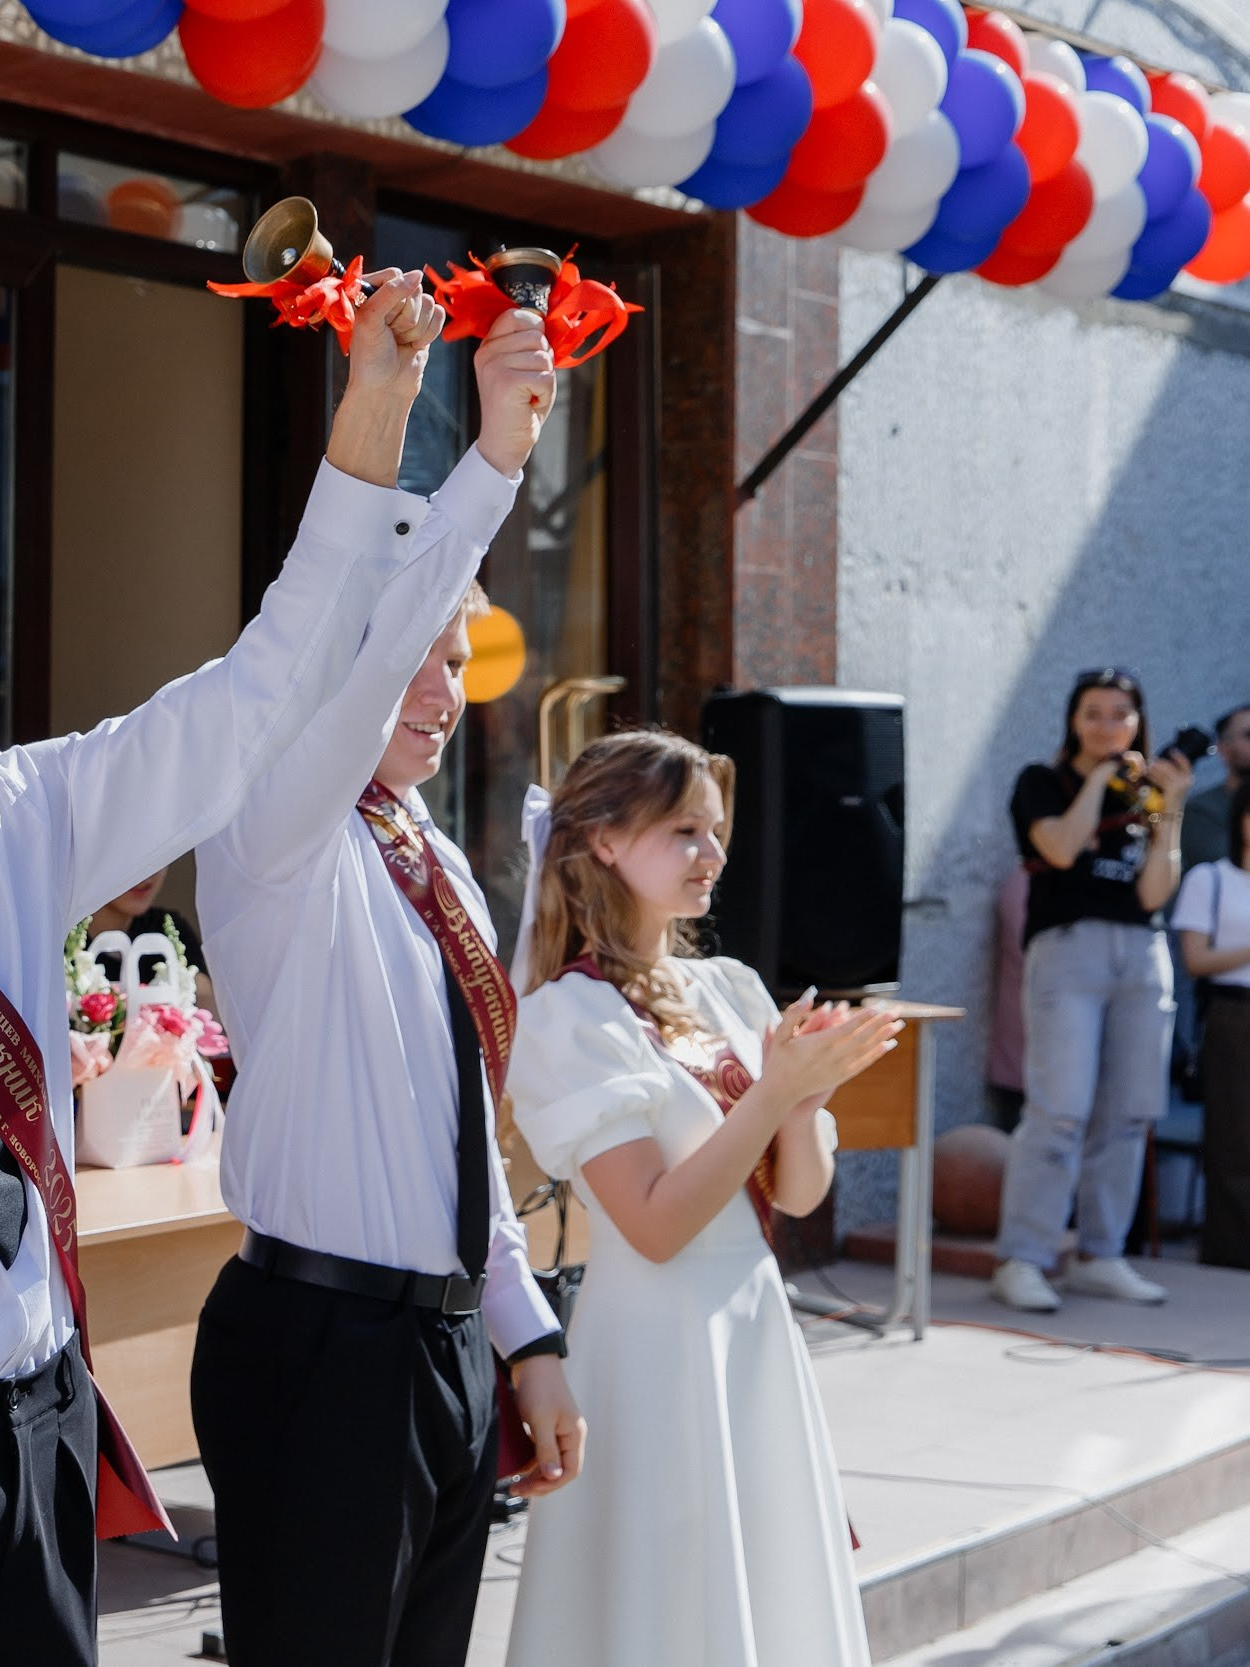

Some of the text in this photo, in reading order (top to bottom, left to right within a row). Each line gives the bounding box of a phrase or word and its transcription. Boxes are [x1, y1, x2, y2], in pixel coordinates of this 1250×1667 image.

[433, 866, 508, 1063] Выпускник
[9, 1134, 47, 1210] НОВОРОС
[44, 1148, 78, 1252] 2025
